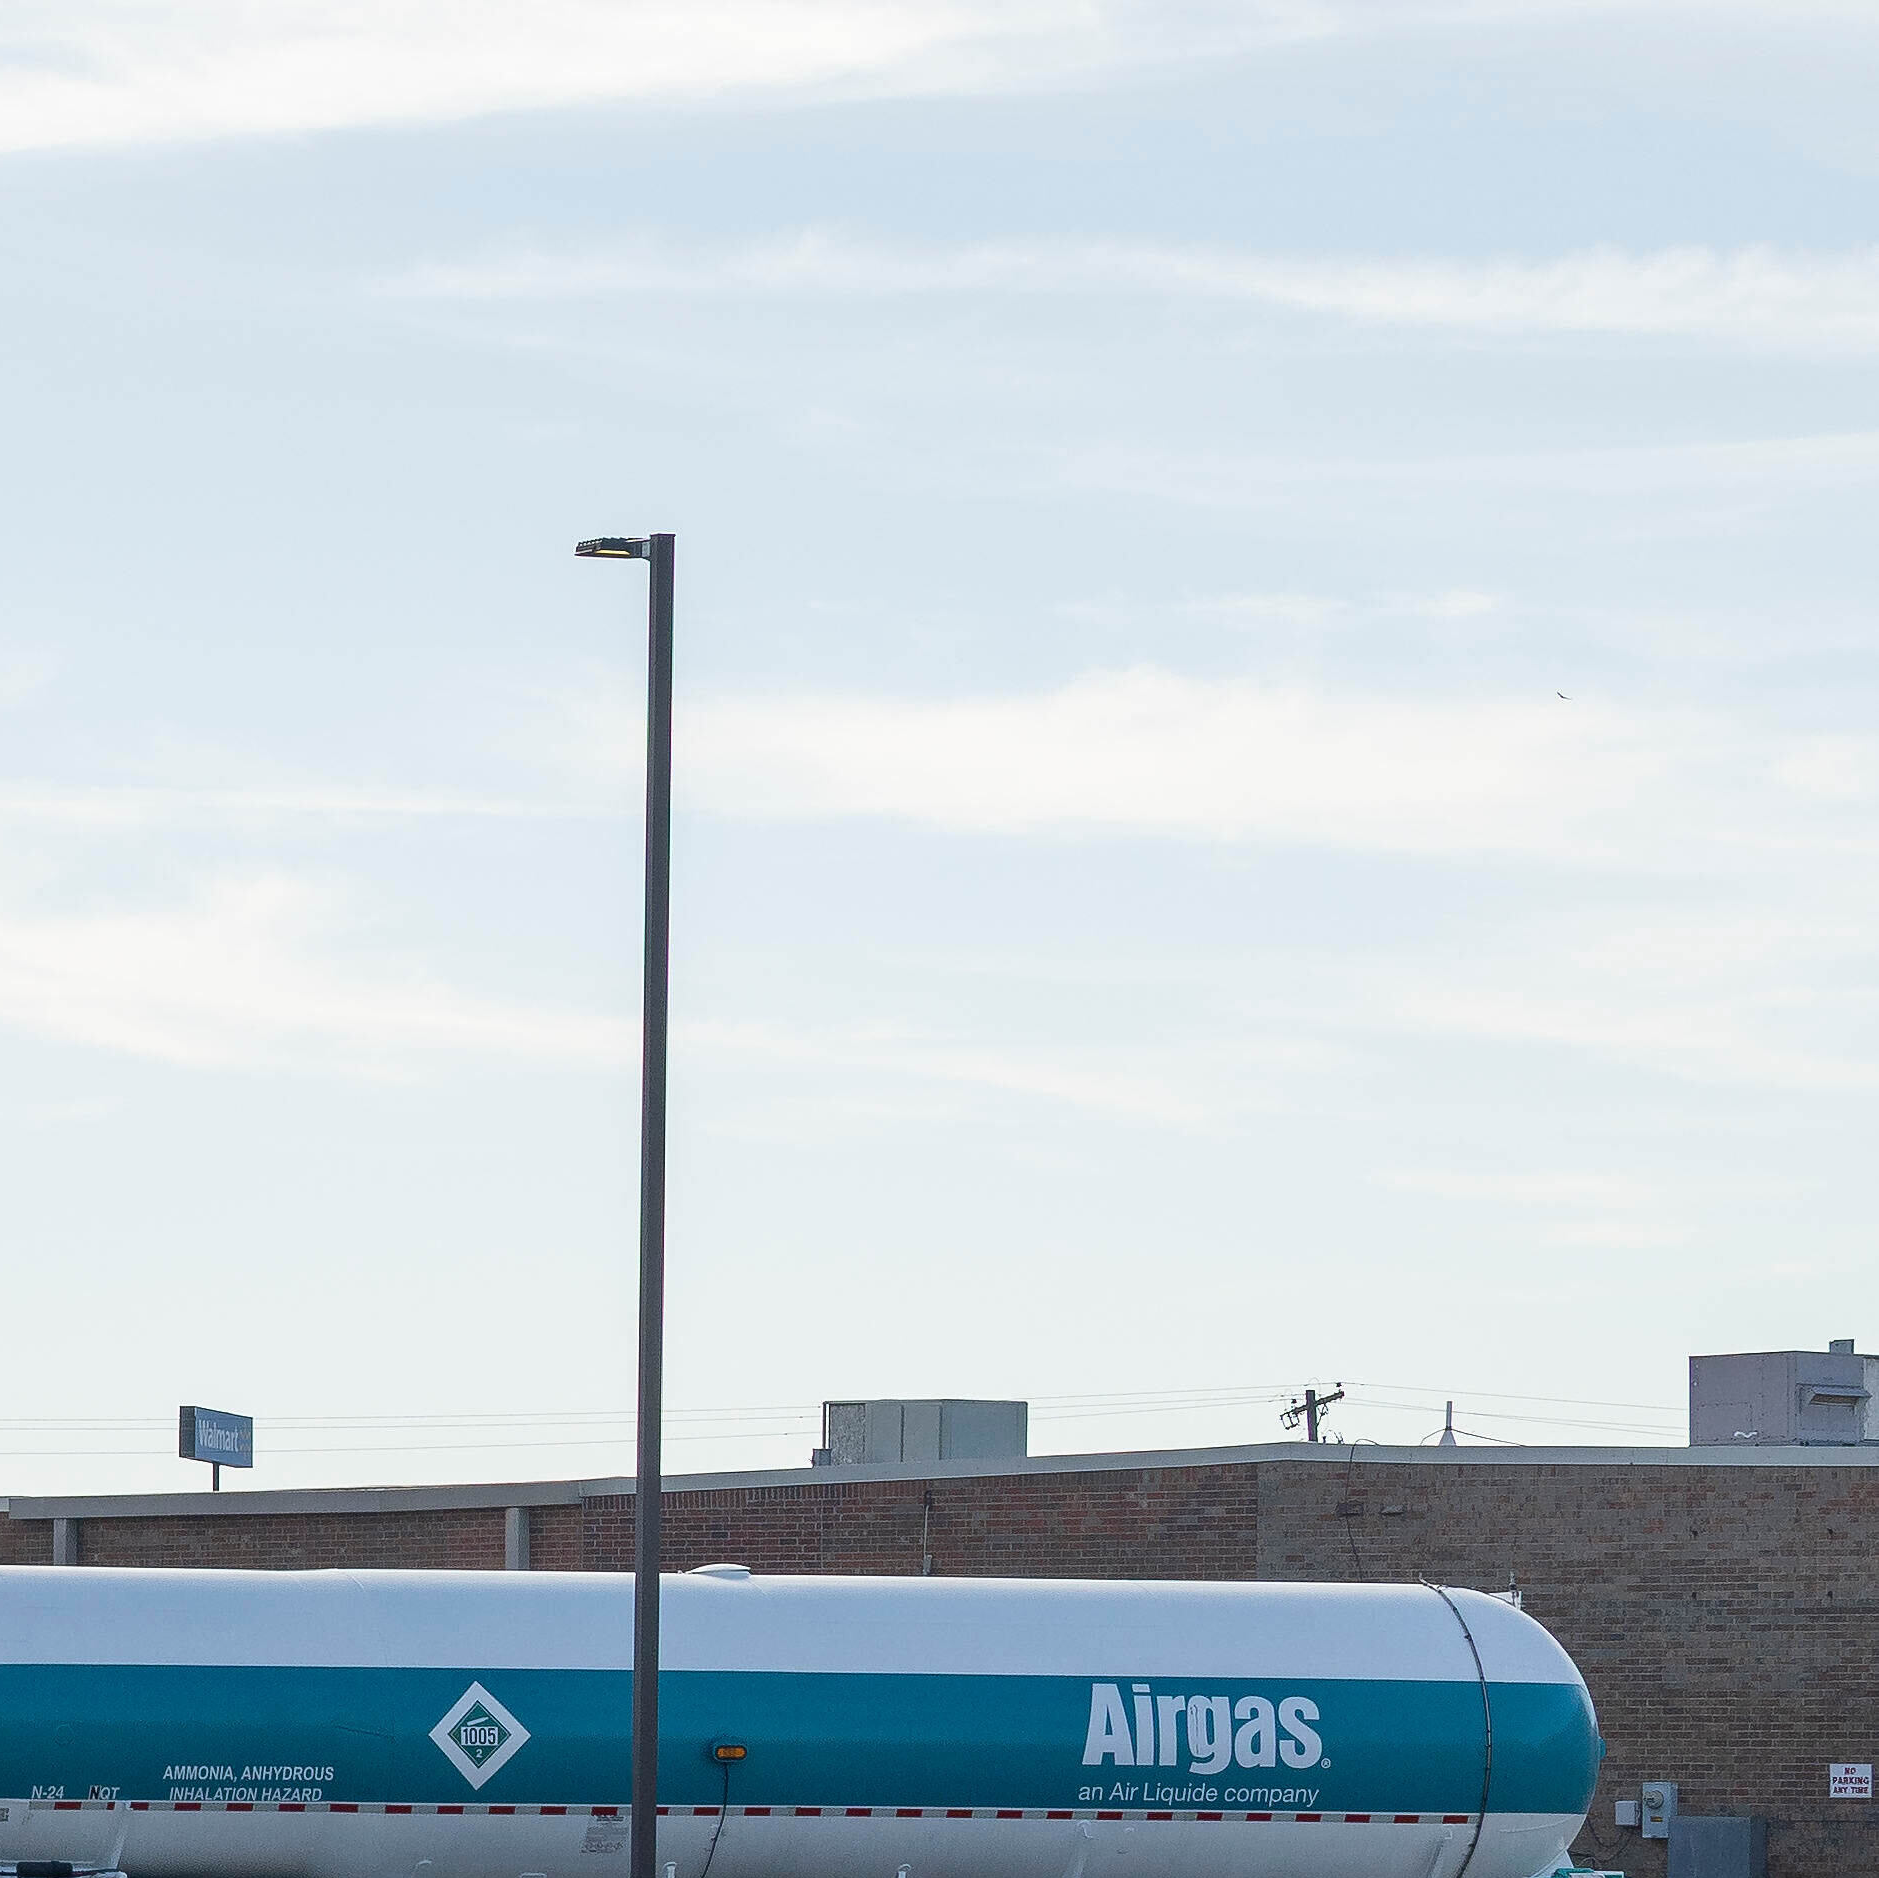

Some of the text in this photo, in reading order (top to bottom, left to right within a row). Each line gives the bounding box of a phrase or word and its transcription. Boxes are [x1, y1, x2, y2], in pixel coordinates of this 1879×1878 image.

[198, 1419, 239, 1453] Walmart
[462, 1727, 496, 1745] 1005
[1081, 1683, 1323, 1775] Airgas
[475, 1748, 483, 1758] 2
[162, 1765, 334, 1781] AMMONIA, ANHYDROUS
[1844, 1767, 1857, 1775] NO
[1832, 1776, 1869, 1785] PARKING
[31, 1785, 64, 1800] N-24
[169, 1787, 323, 1802] INHALATION HAZARD
[1078, 1783, 1320, 1808] an Air Liquide company
[1833, 1786, 1848, 1794] ANY
